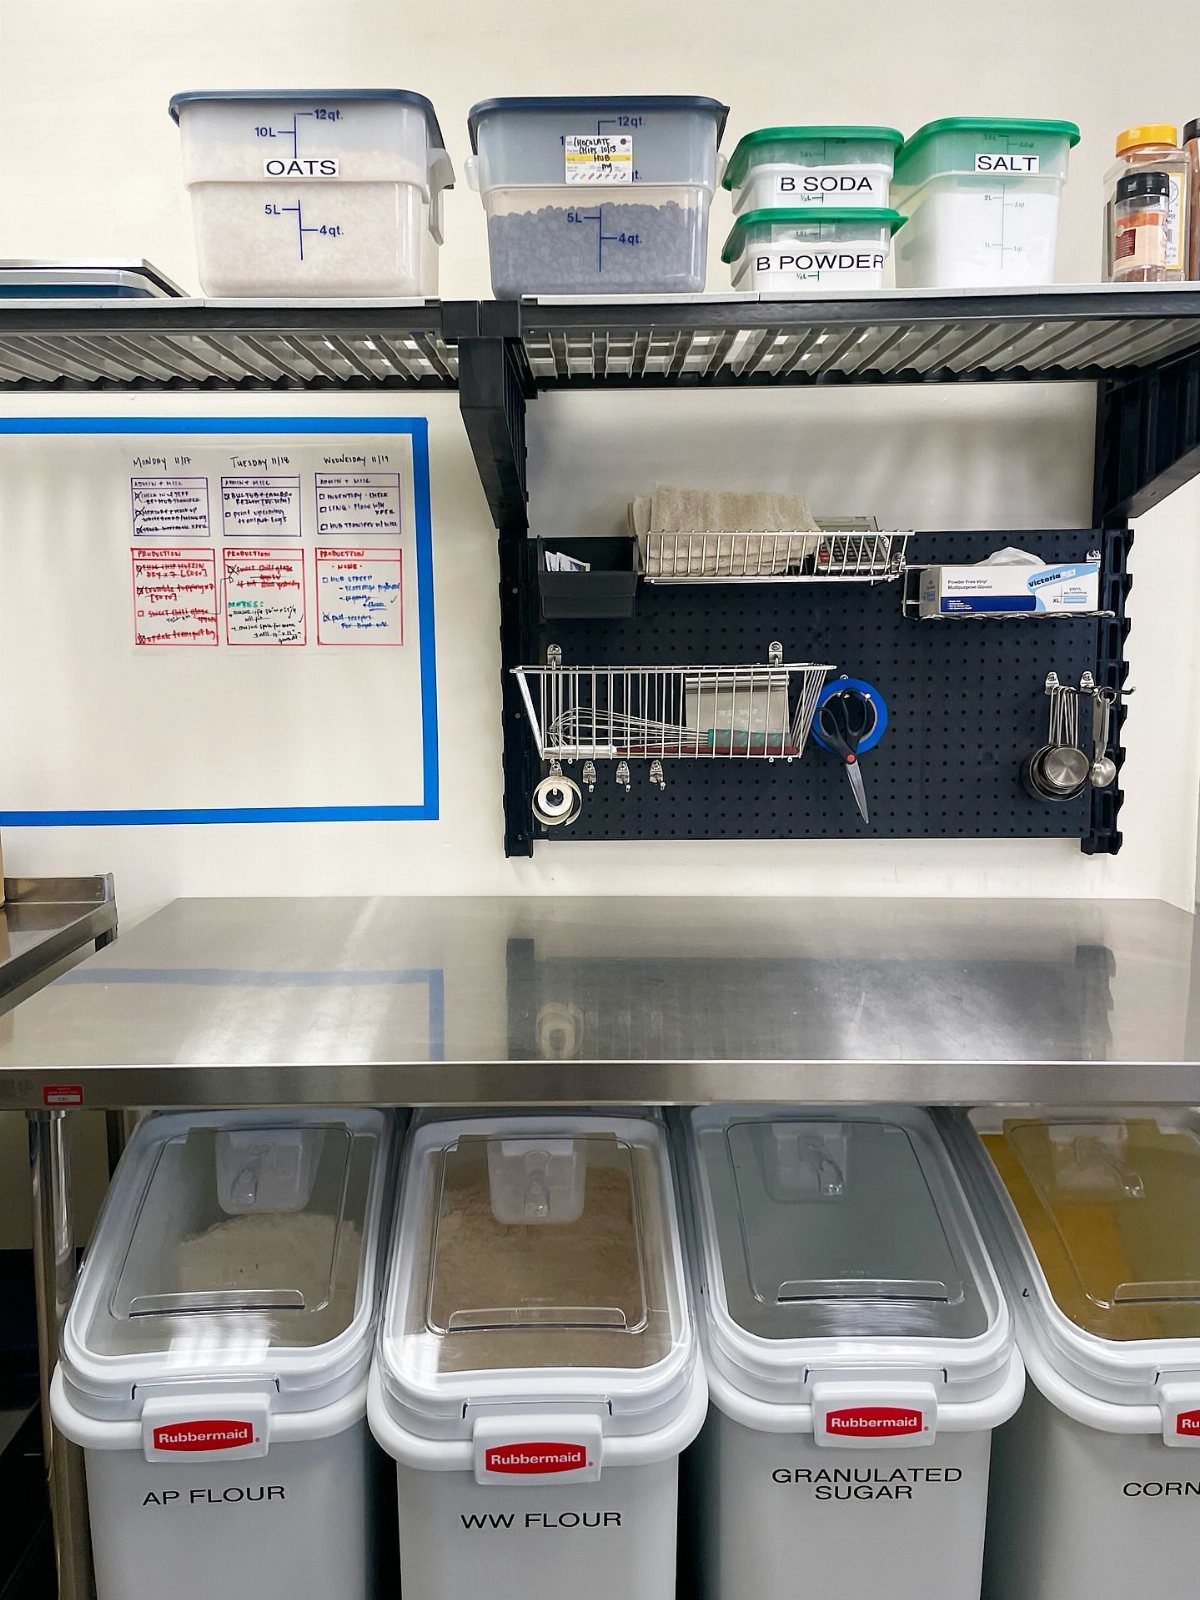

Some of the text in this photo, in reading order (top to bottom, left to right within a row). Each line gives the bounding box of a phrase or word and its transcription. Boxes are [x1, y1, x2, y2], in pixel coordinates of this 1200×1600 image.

[314, 109, 344, 122] 12qt.
[617, 116, 645, 128] 12qt.
[255, 127, 276, 138] 10L
[573, 136, 611, 148] CHOCOLATE
[593, 154, 611, 163] HUB
[977, 155, 1037, 171] SALT
[266, 160, 337, 175] OATS
[780, 176, 873, 191] B SODA
[264, 204, 281, 215] 5L
[567, 212, 582, 223] 5L
[756, 254, 884, 271] B POWDER
[133, 456, 167, 471] MONDAY
[230, 456, 269, 471] TUESDAY
[323, 453, 389, 467] WEDNESDAY 11/19
[320, 550, 364, 558] PRODUCTION
[1028, 573, 1061, 588] Victoria
[831, 1416, 917, 1428] Rubbermaid
[159, 1428, 248, 1444] Rubbermaid
[491, 1451, 581, 1465] Rubbermaid
[771, 1468, 962, 1484] GRANULATED
[142, 1486, 286, 1506] AP FLOUR
[815, 1485, 912, 1500] SUGAR
[461, 1512, 622, 1529] WW FLOUR
